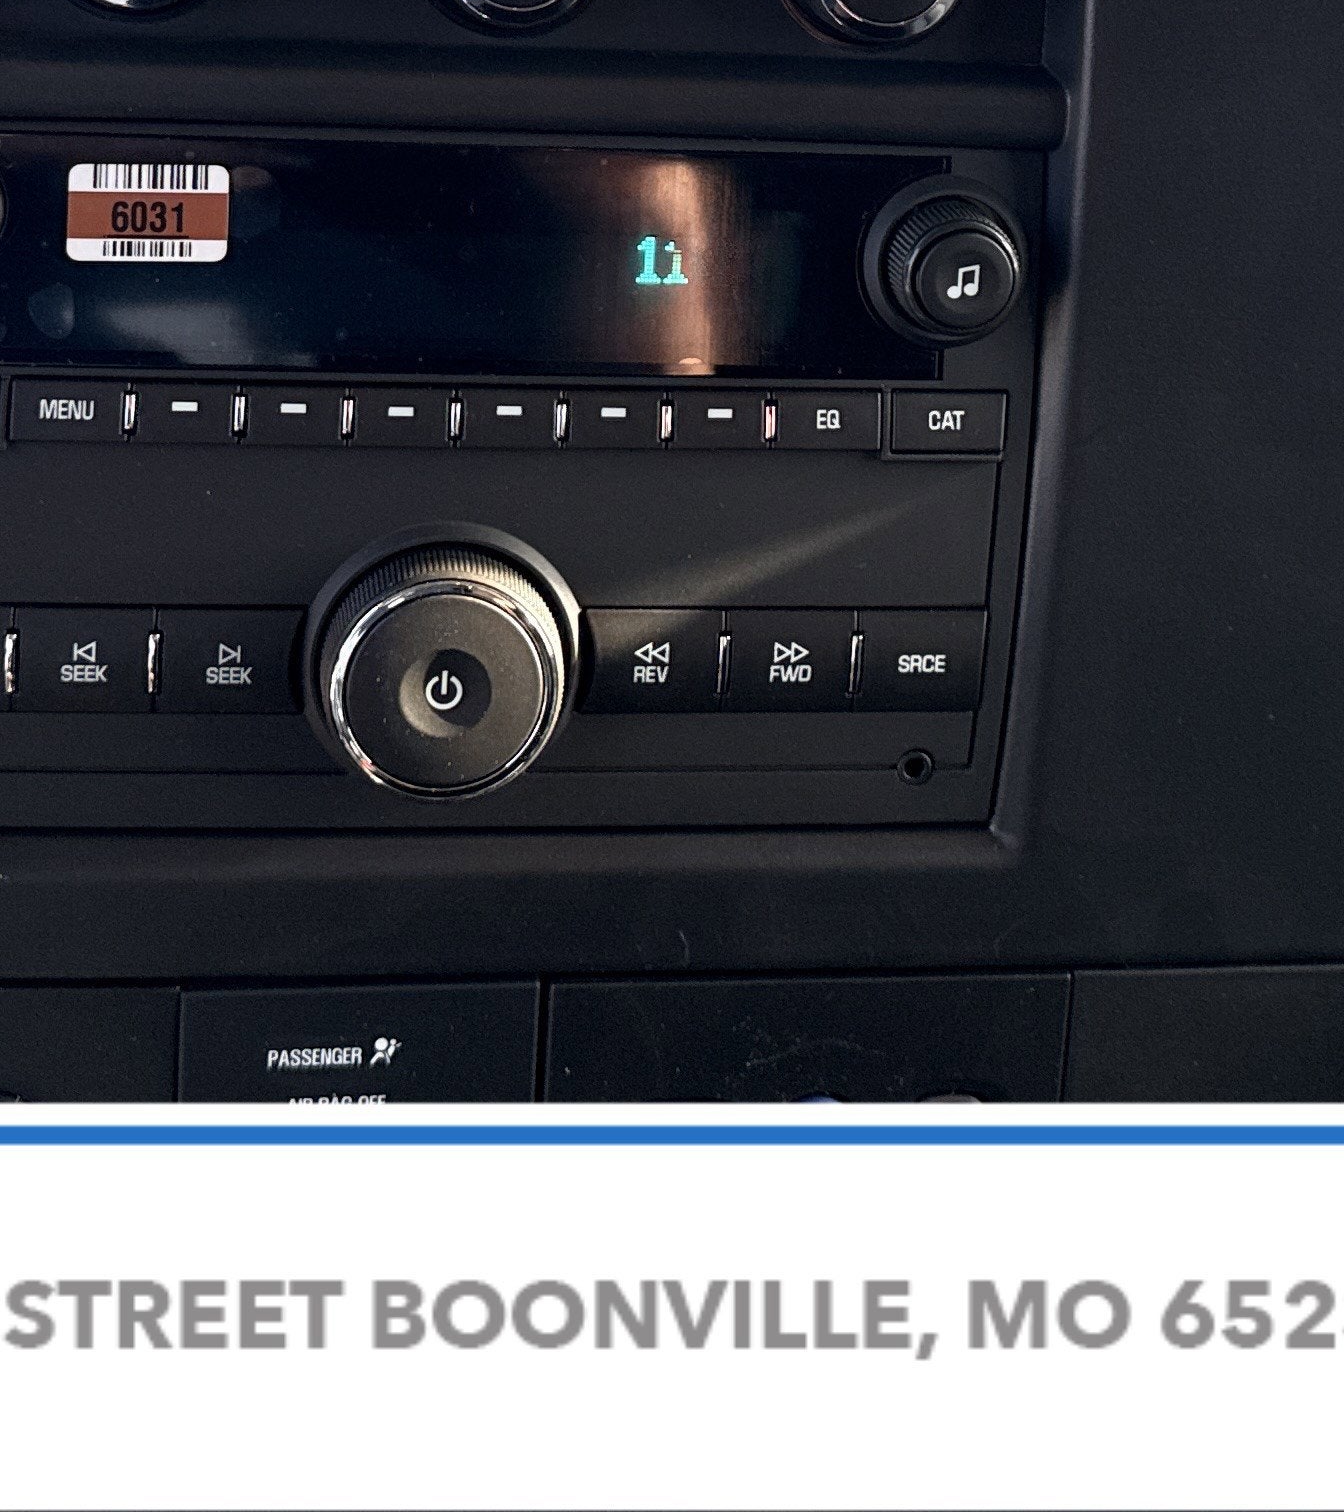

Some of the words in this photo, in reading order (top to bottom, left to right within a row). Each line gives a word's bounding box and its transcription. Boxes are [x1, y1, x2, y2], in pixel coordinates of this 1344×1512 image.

[112, 201, 184, 233] 6031
[39, 398, 95, 421] MENU
[816, 409, 841, 431] EQ
[928, 410, 965, 431] CAT
[60, 664, 108, 683] SEEK
[633, 664, 669, 683] REV
[769, 663, 812, 683] FWD
[897, 654, 946, 673] SRCE
[205, 666, 253, 685] SEEK
[267, 1047, 363, 1067] PASSENGER
